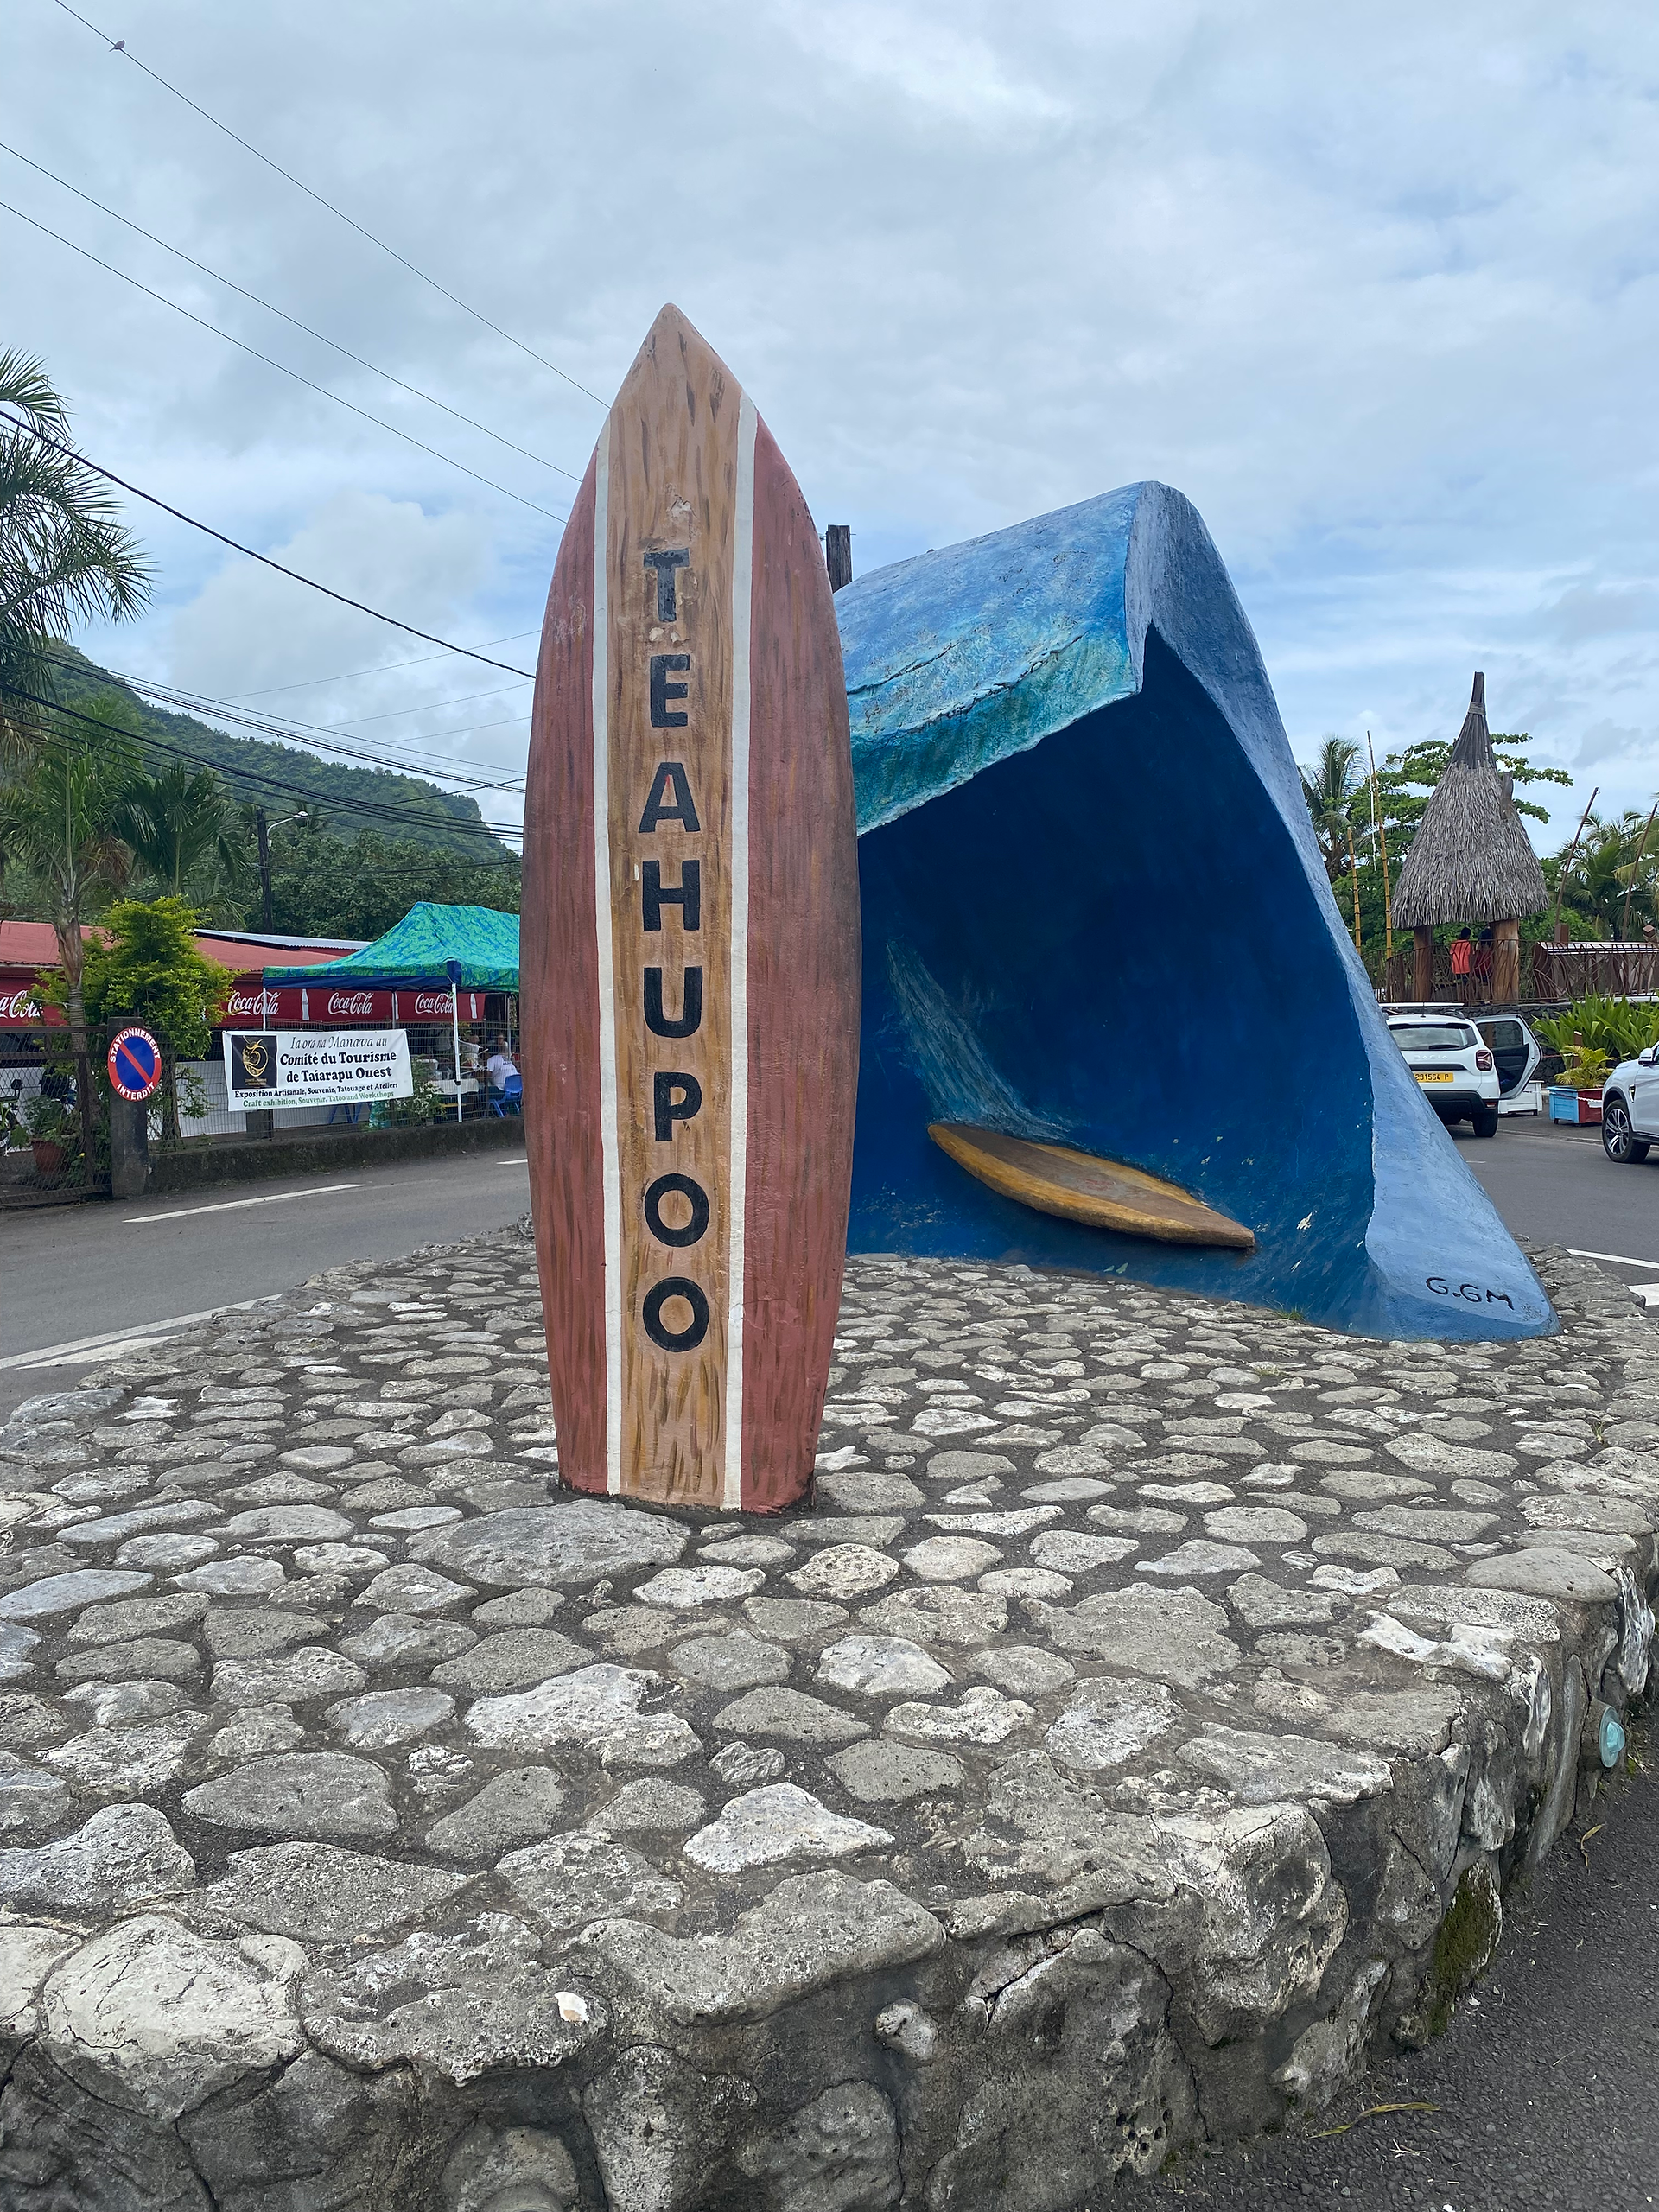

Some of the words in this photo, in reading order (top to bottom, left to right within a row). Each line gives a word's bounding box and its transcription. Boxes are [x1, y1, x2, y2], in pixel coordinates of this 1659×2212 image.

[638, 550, 710, 1353] TEAHUPOO
[327, 991, 373, 1015] Coca-Cola
[110, 1028, 161, 1063] STATIONNEMENT
[302, 1039, 316, 1049] ora
[316, 1039, 327, 1048] na
[327, 1036, 373, 1049] Manava
[376, 1038, 388, 1047] au
[280, 1052, 319, 1065] Comité
[321, 1053, 337, 1065] du
[339, 1051, 397, 1064] Tourisme
[286, 1071, 299, 1083] de
[301, 1069, 353, 1083] Taiarapu
[355, 1066, 392, 1079] Ouest
[116, 1081, 156, 1100] INTERDIT
[234, 1090, 273, 1099] Exposition
[273, 1088, 307, 1096] Artisanale,
[307, 1086, 336, 1095] Souvenir,
[336, 1084, 366, 1093] Tatouage
[298, 1096, 328, 1104] Souvenir,
[328, 1094, 346, 1103] Tatoo
[359, 1090, 395, 1100] Workshops
